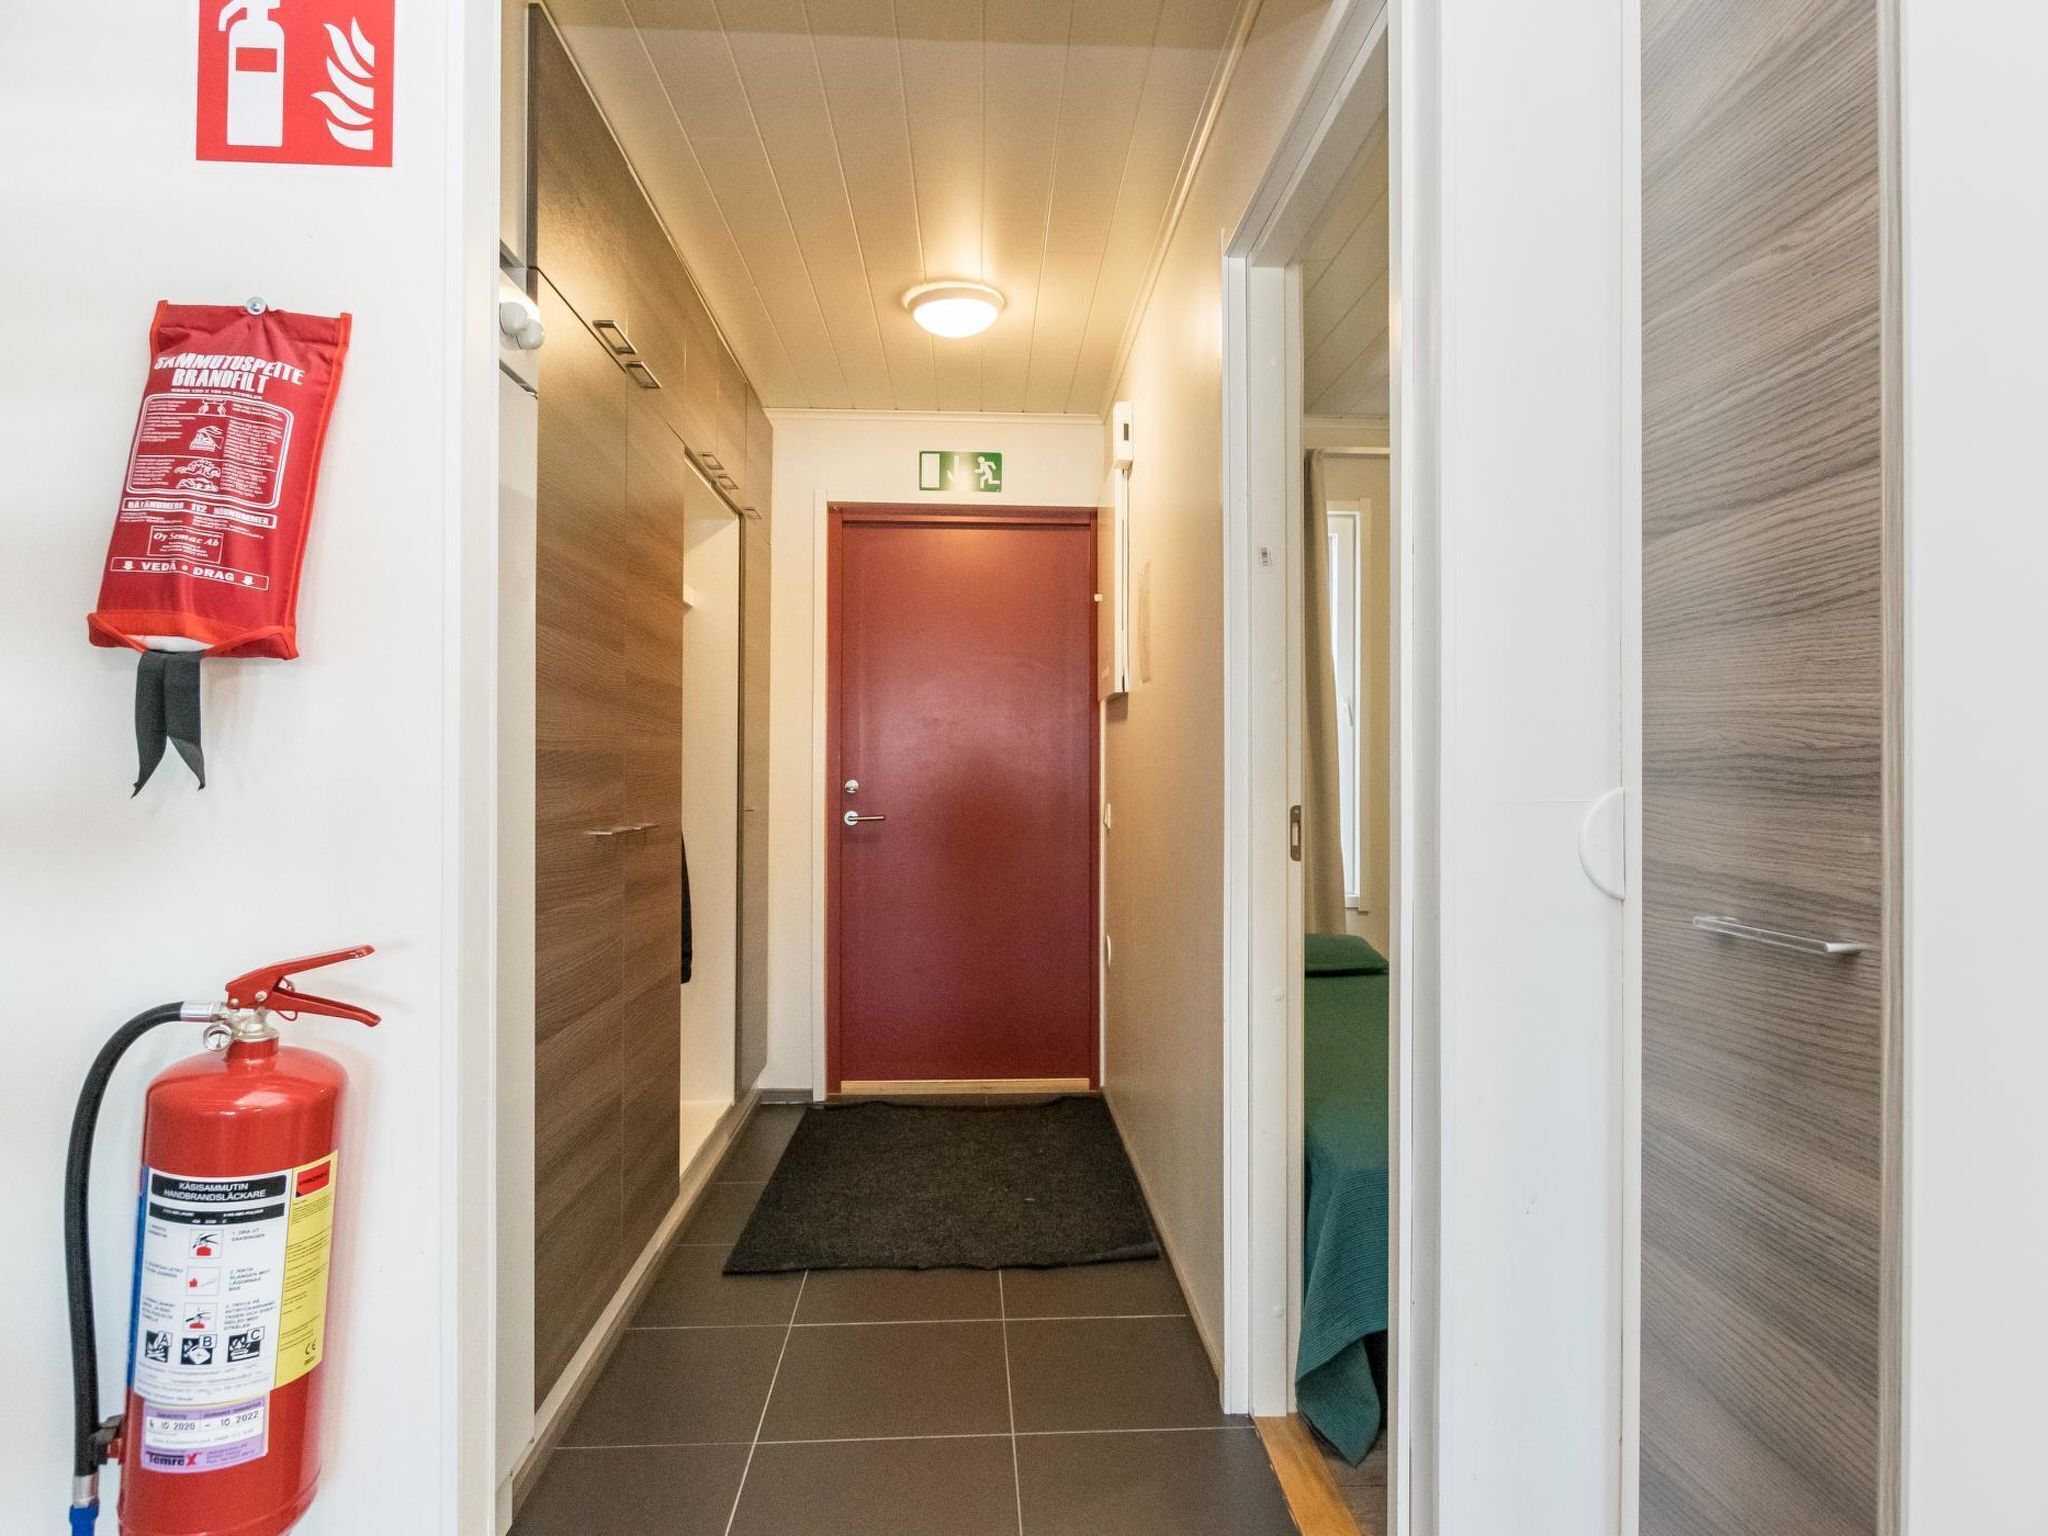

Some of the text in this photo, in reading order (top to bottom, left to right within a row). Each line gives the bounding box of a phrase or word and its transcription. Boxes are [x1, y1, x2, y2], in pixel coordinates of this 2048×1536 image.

[154, 352, 305, 385] SAMMUTUSPEITE
[171, 368, 270, 393] BRANDFILT
[153, 532, 167, 541] Oy
[204, 538, 220, 547] Ab
[193, 566, 235, 581] DRAG
[179, 1182, 248, 1192] KÄSISAMMUTIN
[164, 1189, 266, 1201] HANDBRANDSLÄCKARE
[160, 1334, 168, 1344] A
[203, 1336, 212, 1346] B
[251, 1330, 260, 1340] C
[174, 1422, 196, 1431] 2020
[236, 1410, 259, 1424] 2022
